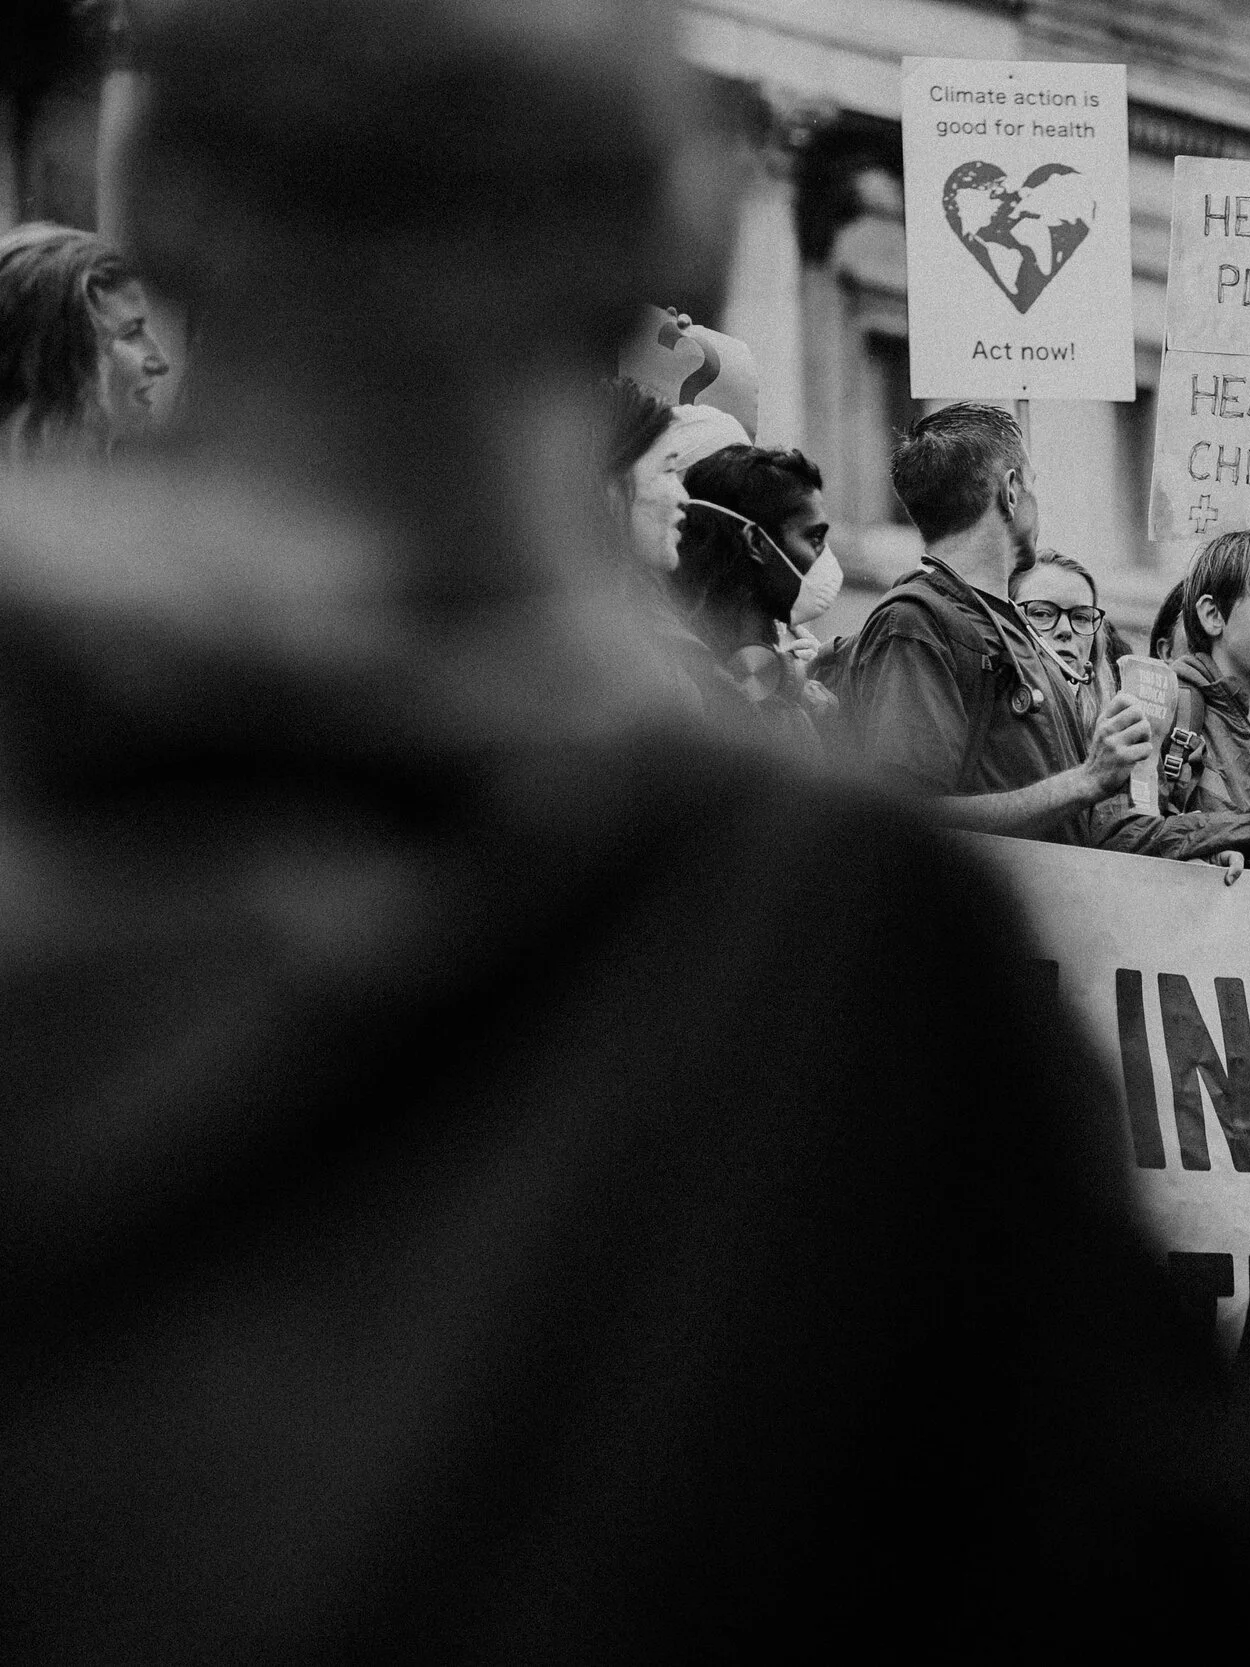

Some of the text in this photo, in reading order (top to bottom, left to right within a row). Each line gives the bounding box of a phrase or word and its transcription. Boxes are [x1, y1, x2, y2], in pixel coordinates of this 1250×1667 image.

[929, 84, 1100, 108] Climate action is
[936, 118, 1096, 139] good for health
[972, 340, 1077, 362] Act now!
